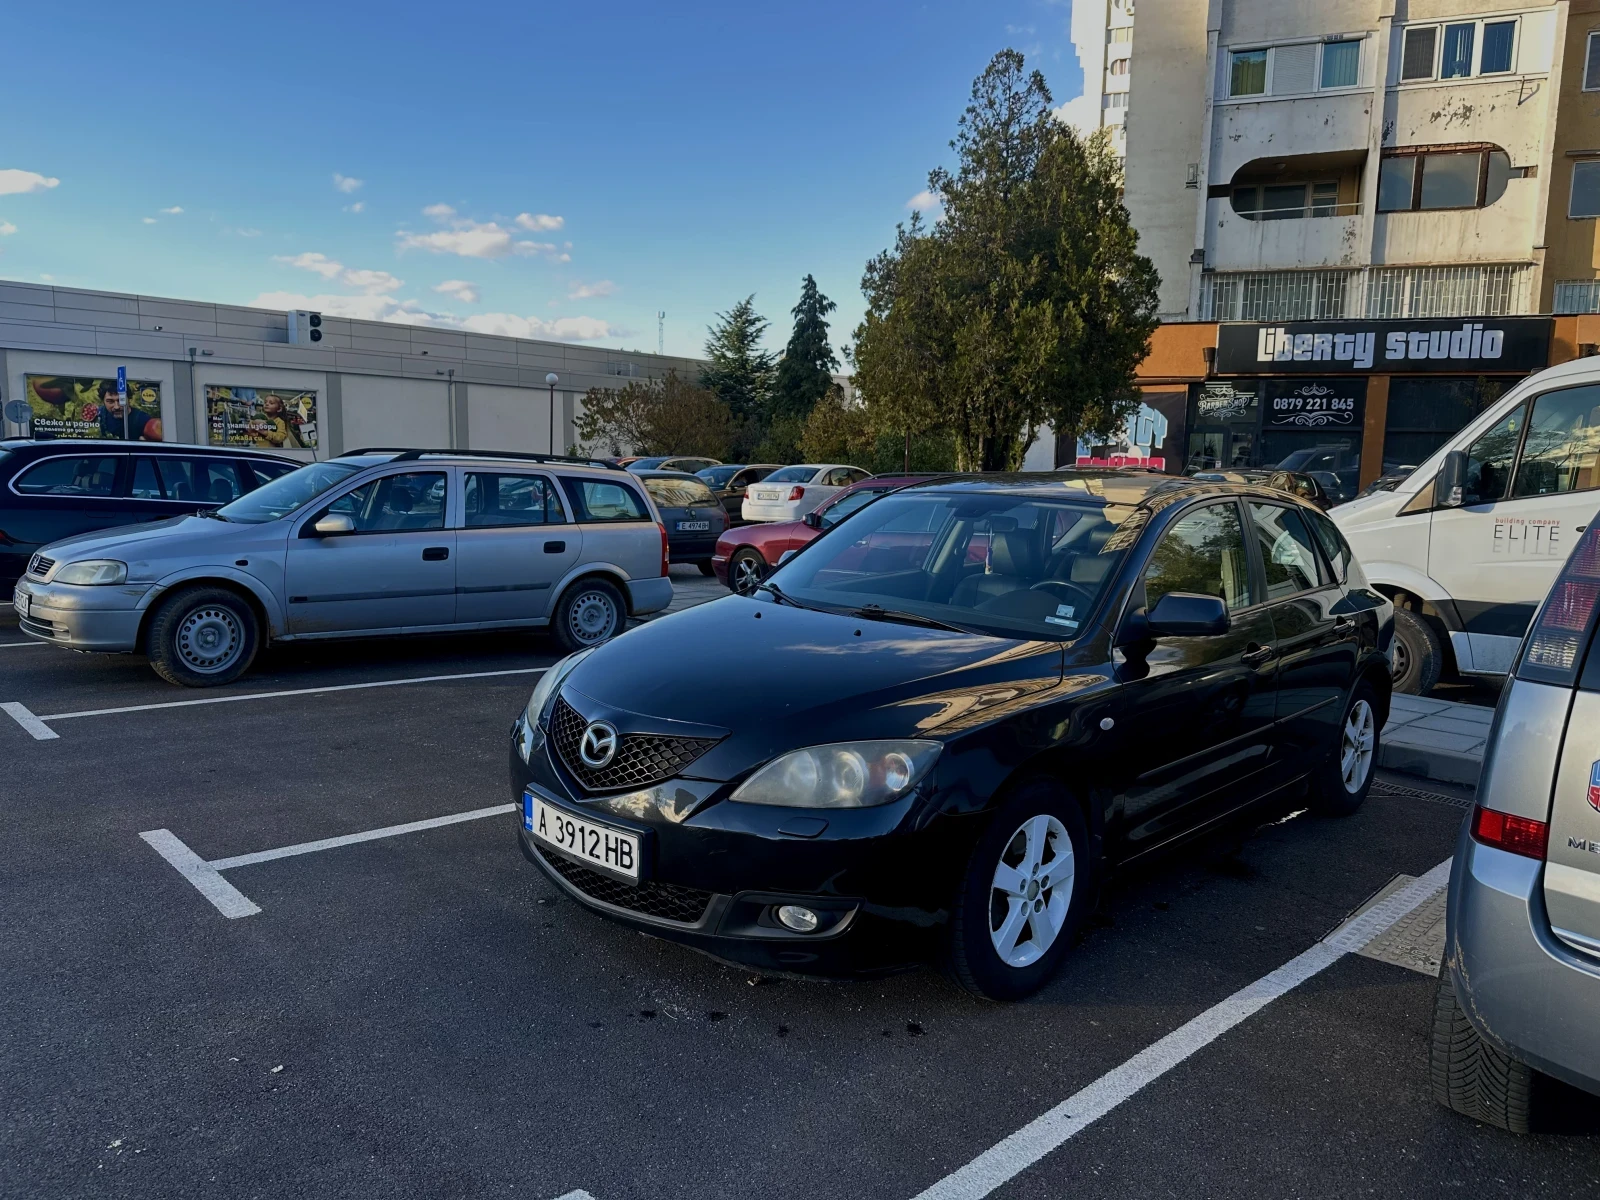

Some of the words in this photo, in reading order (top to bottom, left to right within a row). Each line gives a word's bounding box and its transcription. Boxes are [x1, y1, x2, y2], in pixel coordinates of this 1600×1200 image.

[1273, 398, 1302, 411] 0879
[1305, 398, 1327, 410] 221
[1330, 397, 1354, 410] 845
[34, 418, 64, 426] Свежо
[73, 420, 100, 428] родно
[1495, 517, 1525, 525] building
[1493, 524, 1560, 542] ELITE
[539, 807, 548, 837] A
